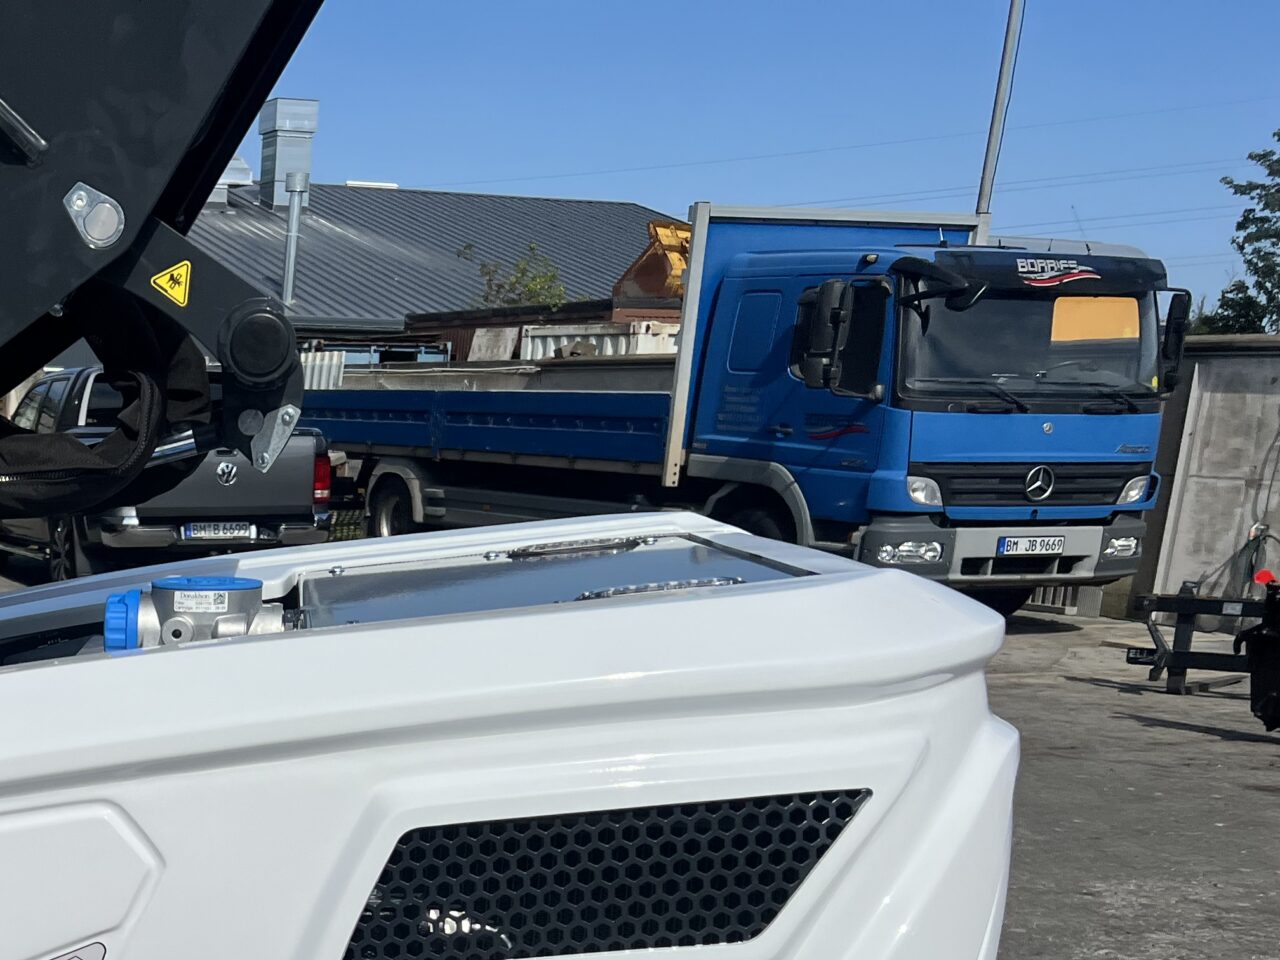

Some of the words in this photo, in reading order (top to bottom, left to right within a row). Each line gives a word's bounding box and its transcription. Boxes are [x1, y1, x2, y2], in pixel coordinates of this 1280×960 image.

[222, 523, 248, 535] 6699
[1006, 539, 1019, 552] BM
[1025, 539, 1038, 552] JB
[1039, 539, 1063, 552] 9669
